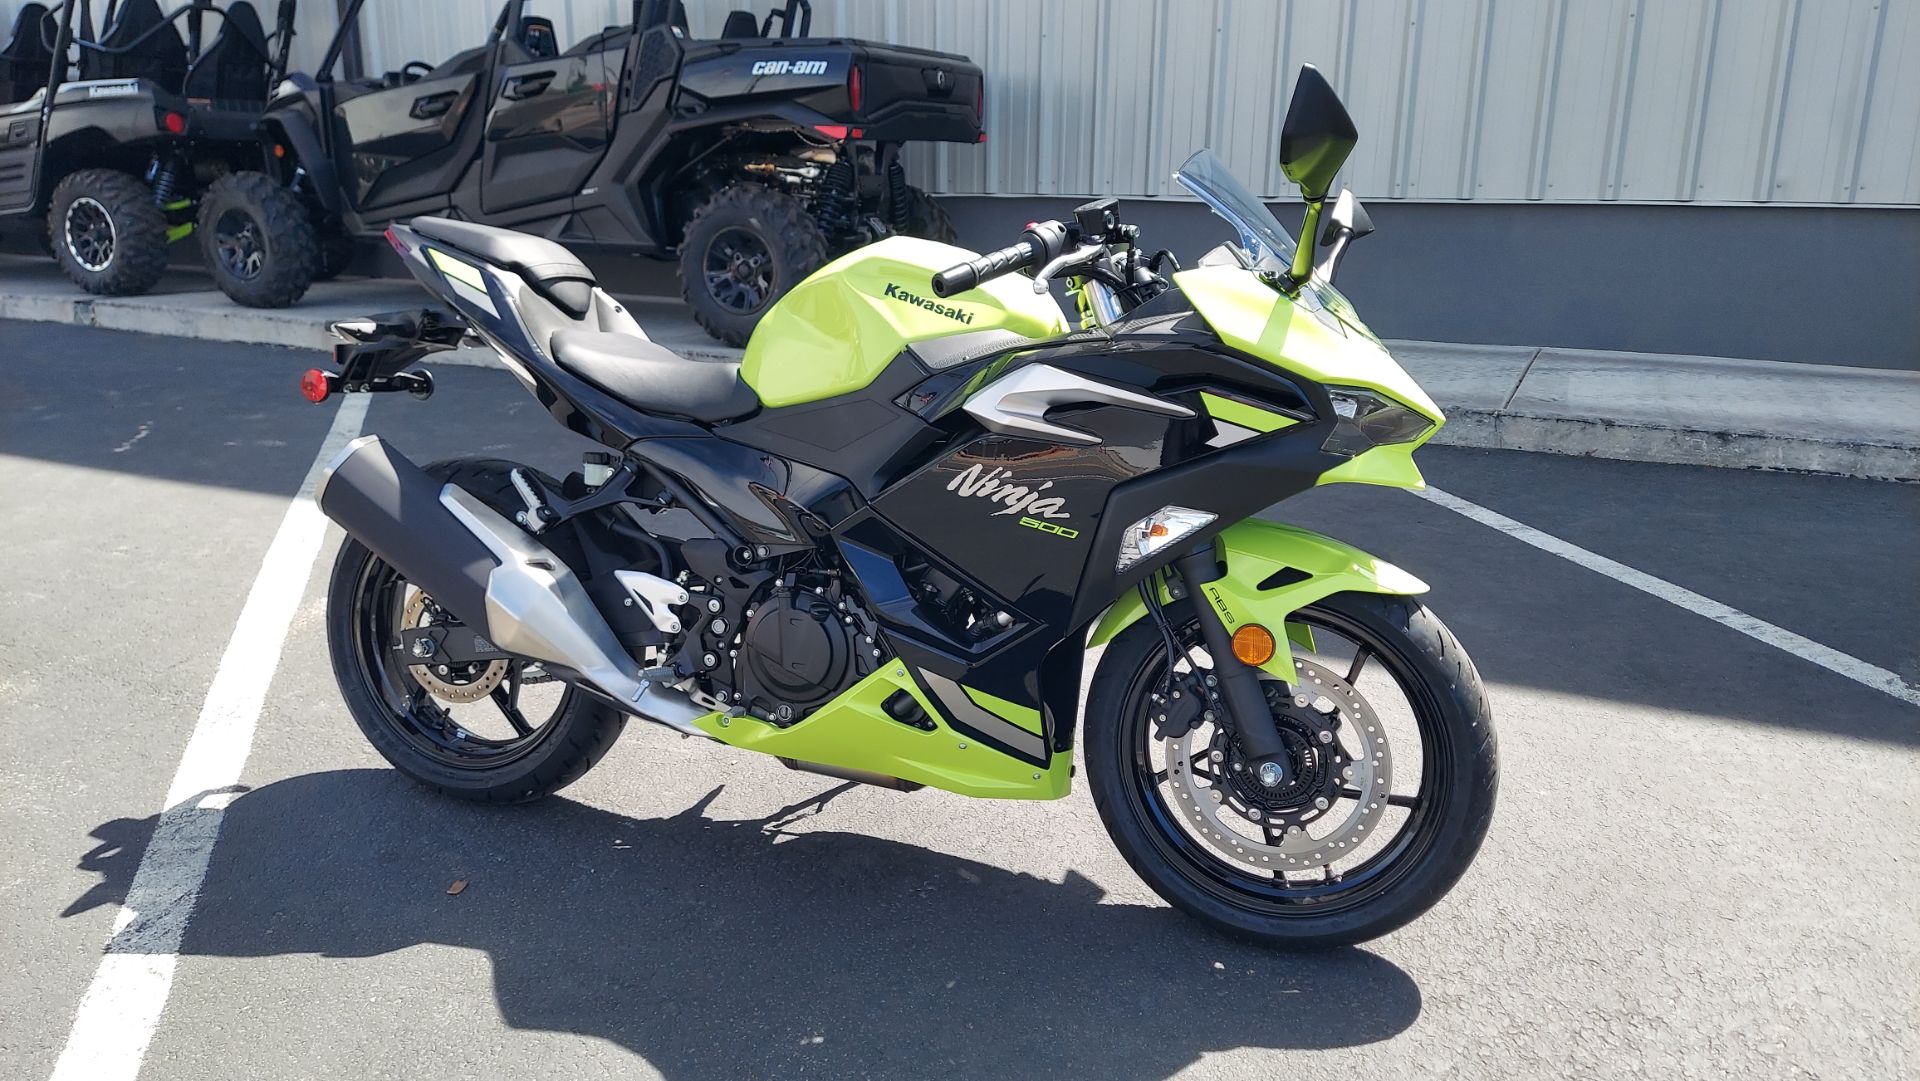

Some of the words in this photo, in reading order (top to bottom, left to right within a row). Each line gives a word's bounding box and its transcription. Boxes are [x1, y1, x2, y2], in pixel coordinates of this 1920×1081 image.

[752, 60, 828, 75] can-am
[884, 282, 974, 325] Kawasaki
[946, 463, 1070, 518] Ninja
[1019, 516, 1079, 539] 500
[1209, 587, 1235, 624] ABS
